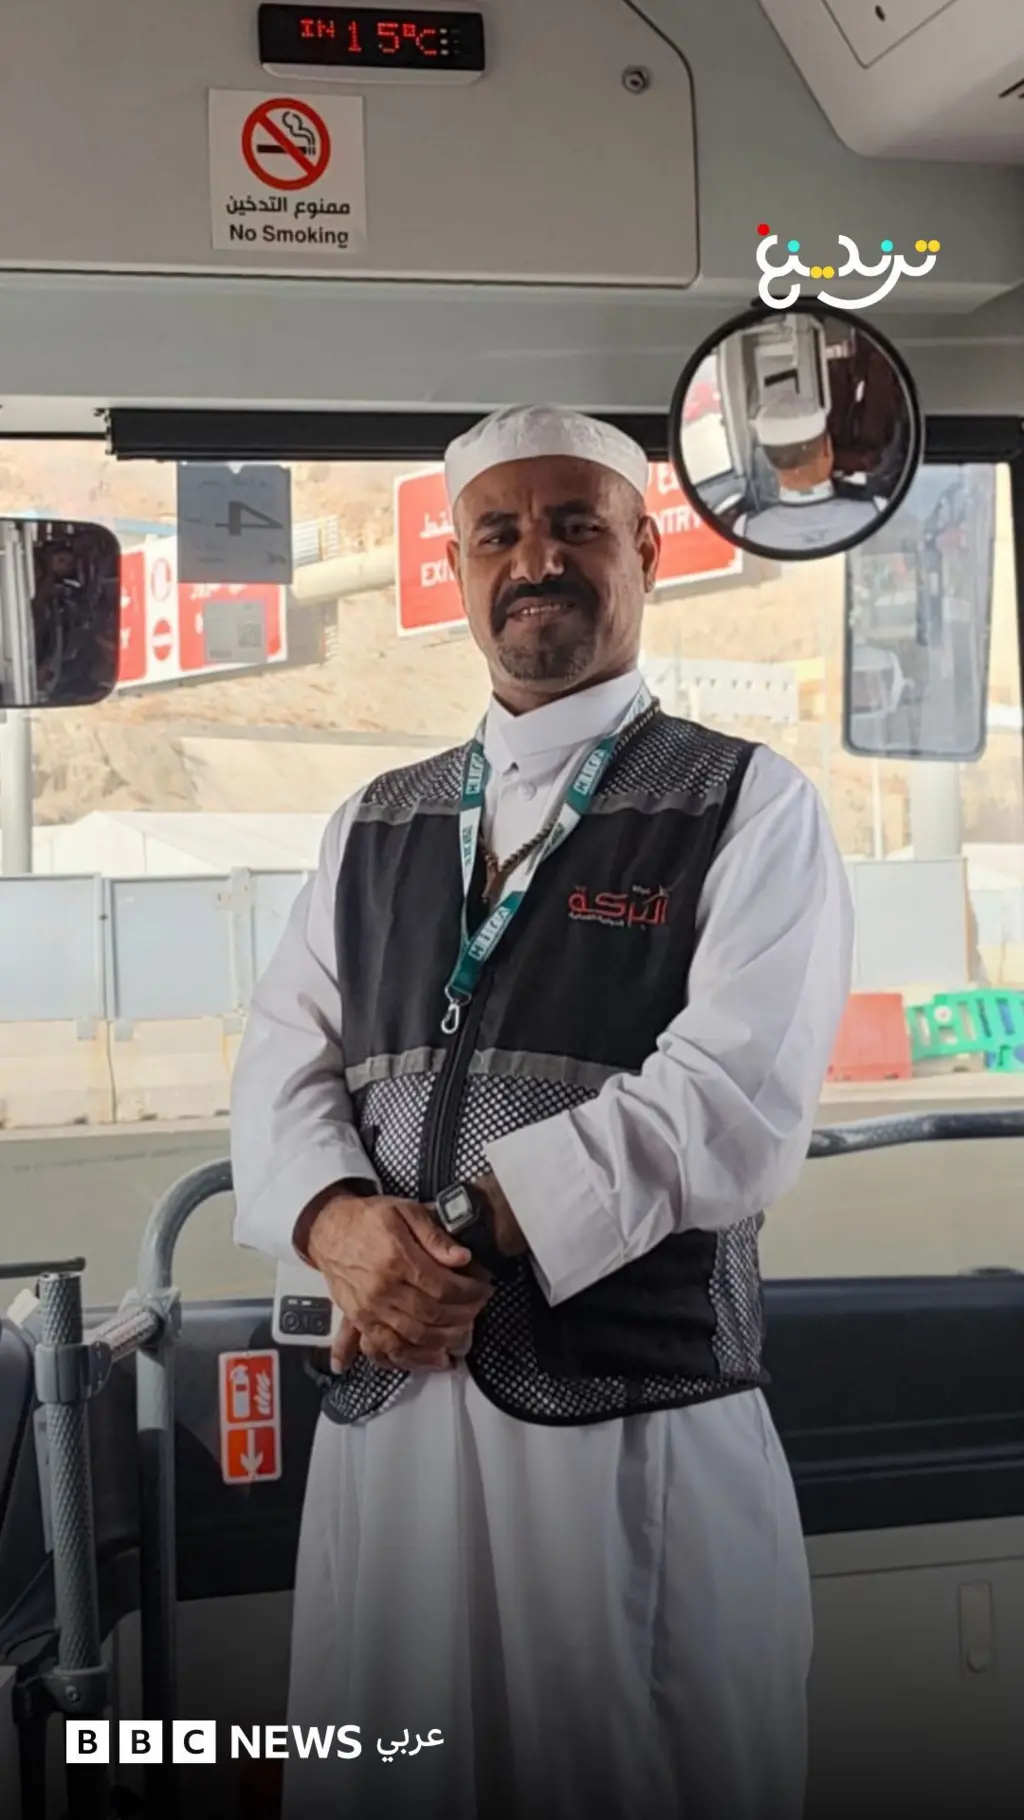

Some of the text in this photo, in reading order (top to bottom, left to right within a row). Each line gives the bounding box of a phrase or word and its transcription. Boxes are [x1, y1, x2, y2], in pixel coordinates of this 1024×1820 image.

[300, 18, 335, 38] IN
[225, 195, 351, 220] ممنوع التدخين
[229, 223, 349, 248] No Smoking
